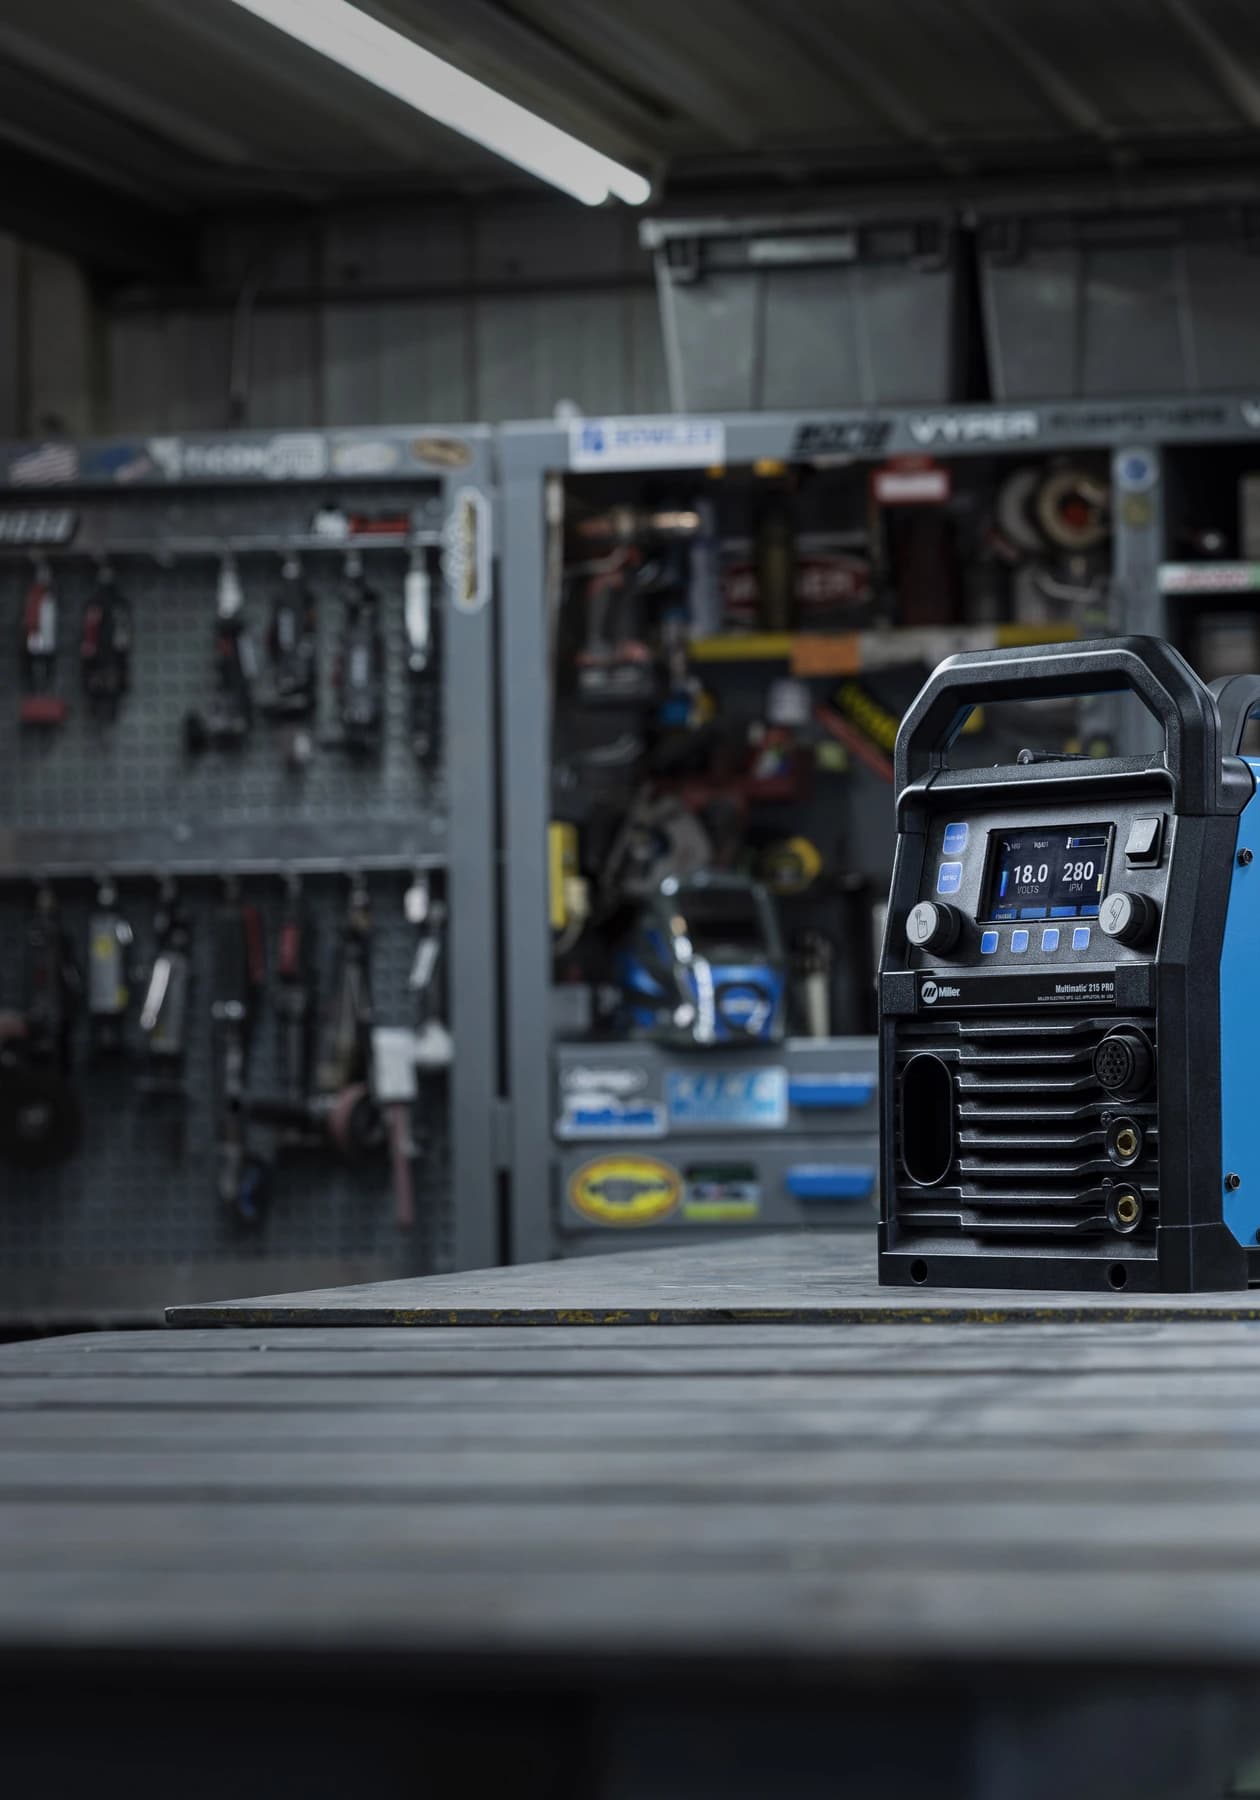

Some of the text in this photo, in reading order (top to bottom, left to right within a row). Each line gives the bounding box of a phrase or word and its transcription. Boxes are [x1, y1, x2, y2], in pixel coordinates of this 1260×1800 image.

[909, 409, 1039, 444] VYPER
[1014, 861, 1094, 884] 18.0 280
[1017, 883, 1083, 895] VOLTS IPM
[938, 986, 960, 998] Miller
[1088, 983, 1100, 992] 215
[1101, 982, 1114, 992] PRO
